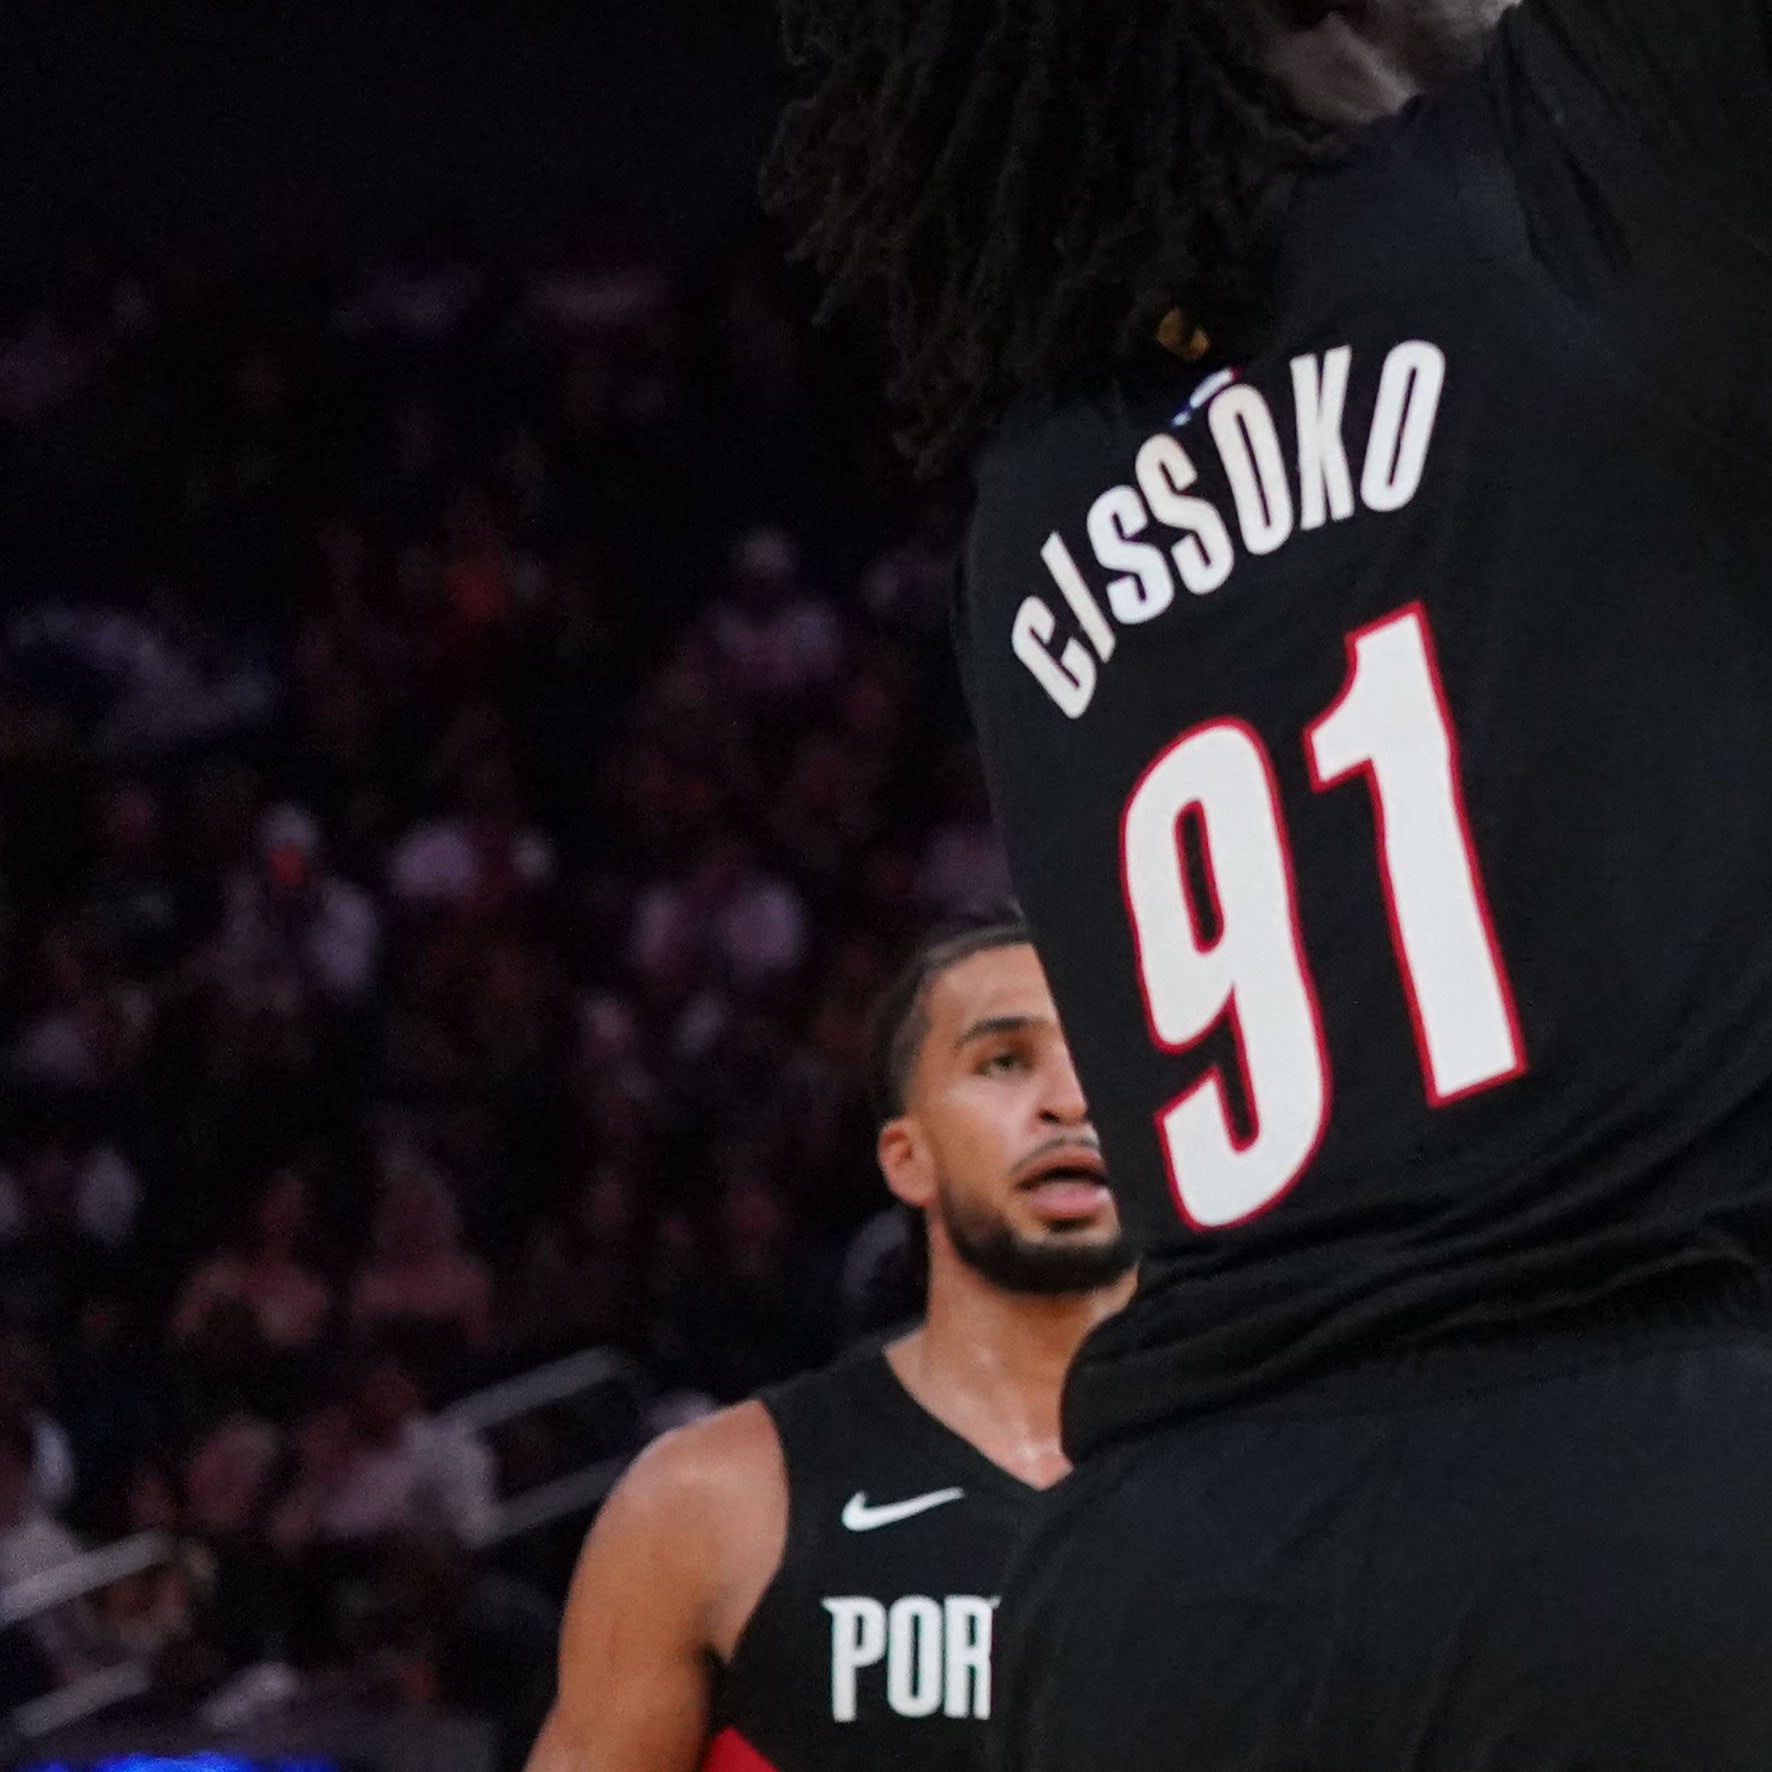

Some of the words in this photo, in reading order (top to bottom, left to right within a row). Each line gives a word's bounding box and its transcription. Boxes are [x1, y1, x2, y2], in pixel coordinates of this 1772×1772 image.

[1011, 339, 1447, 719] CISSOKO
[1118, 599, 1529, 1231] 91
[821, 1594, 1002, 1724] POR
